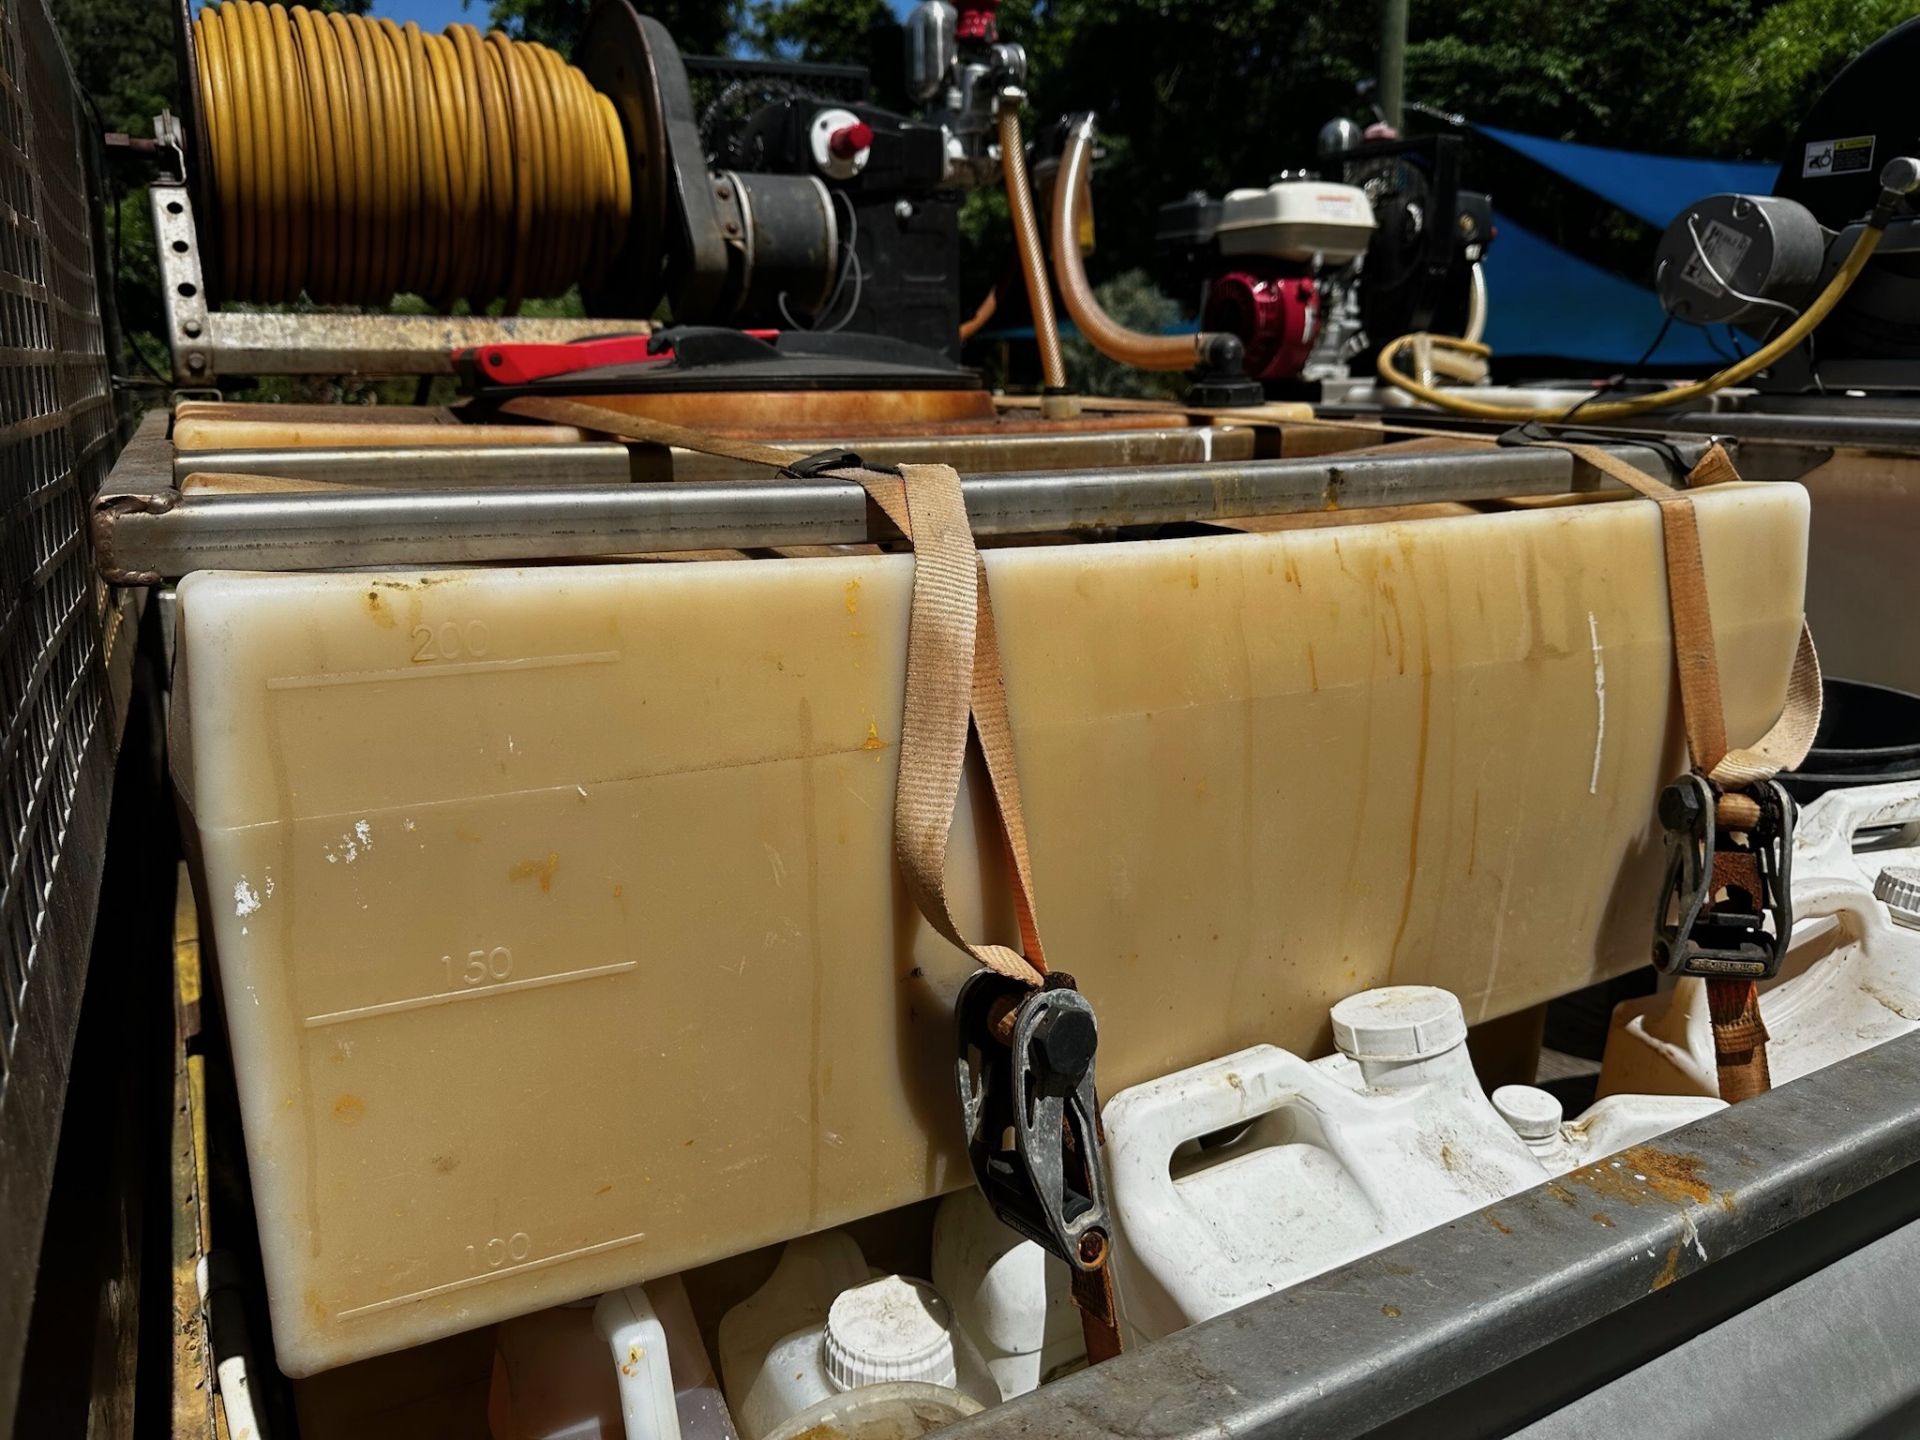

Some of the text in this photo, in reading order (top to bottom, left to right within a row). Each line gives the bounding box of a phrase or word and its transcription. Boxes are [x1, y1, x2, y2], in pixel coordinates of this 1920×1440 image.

[411, 620, 489, 662] 200
[441, 946, 513, 986] 150
[465, 1232, 530, 1269] 100
